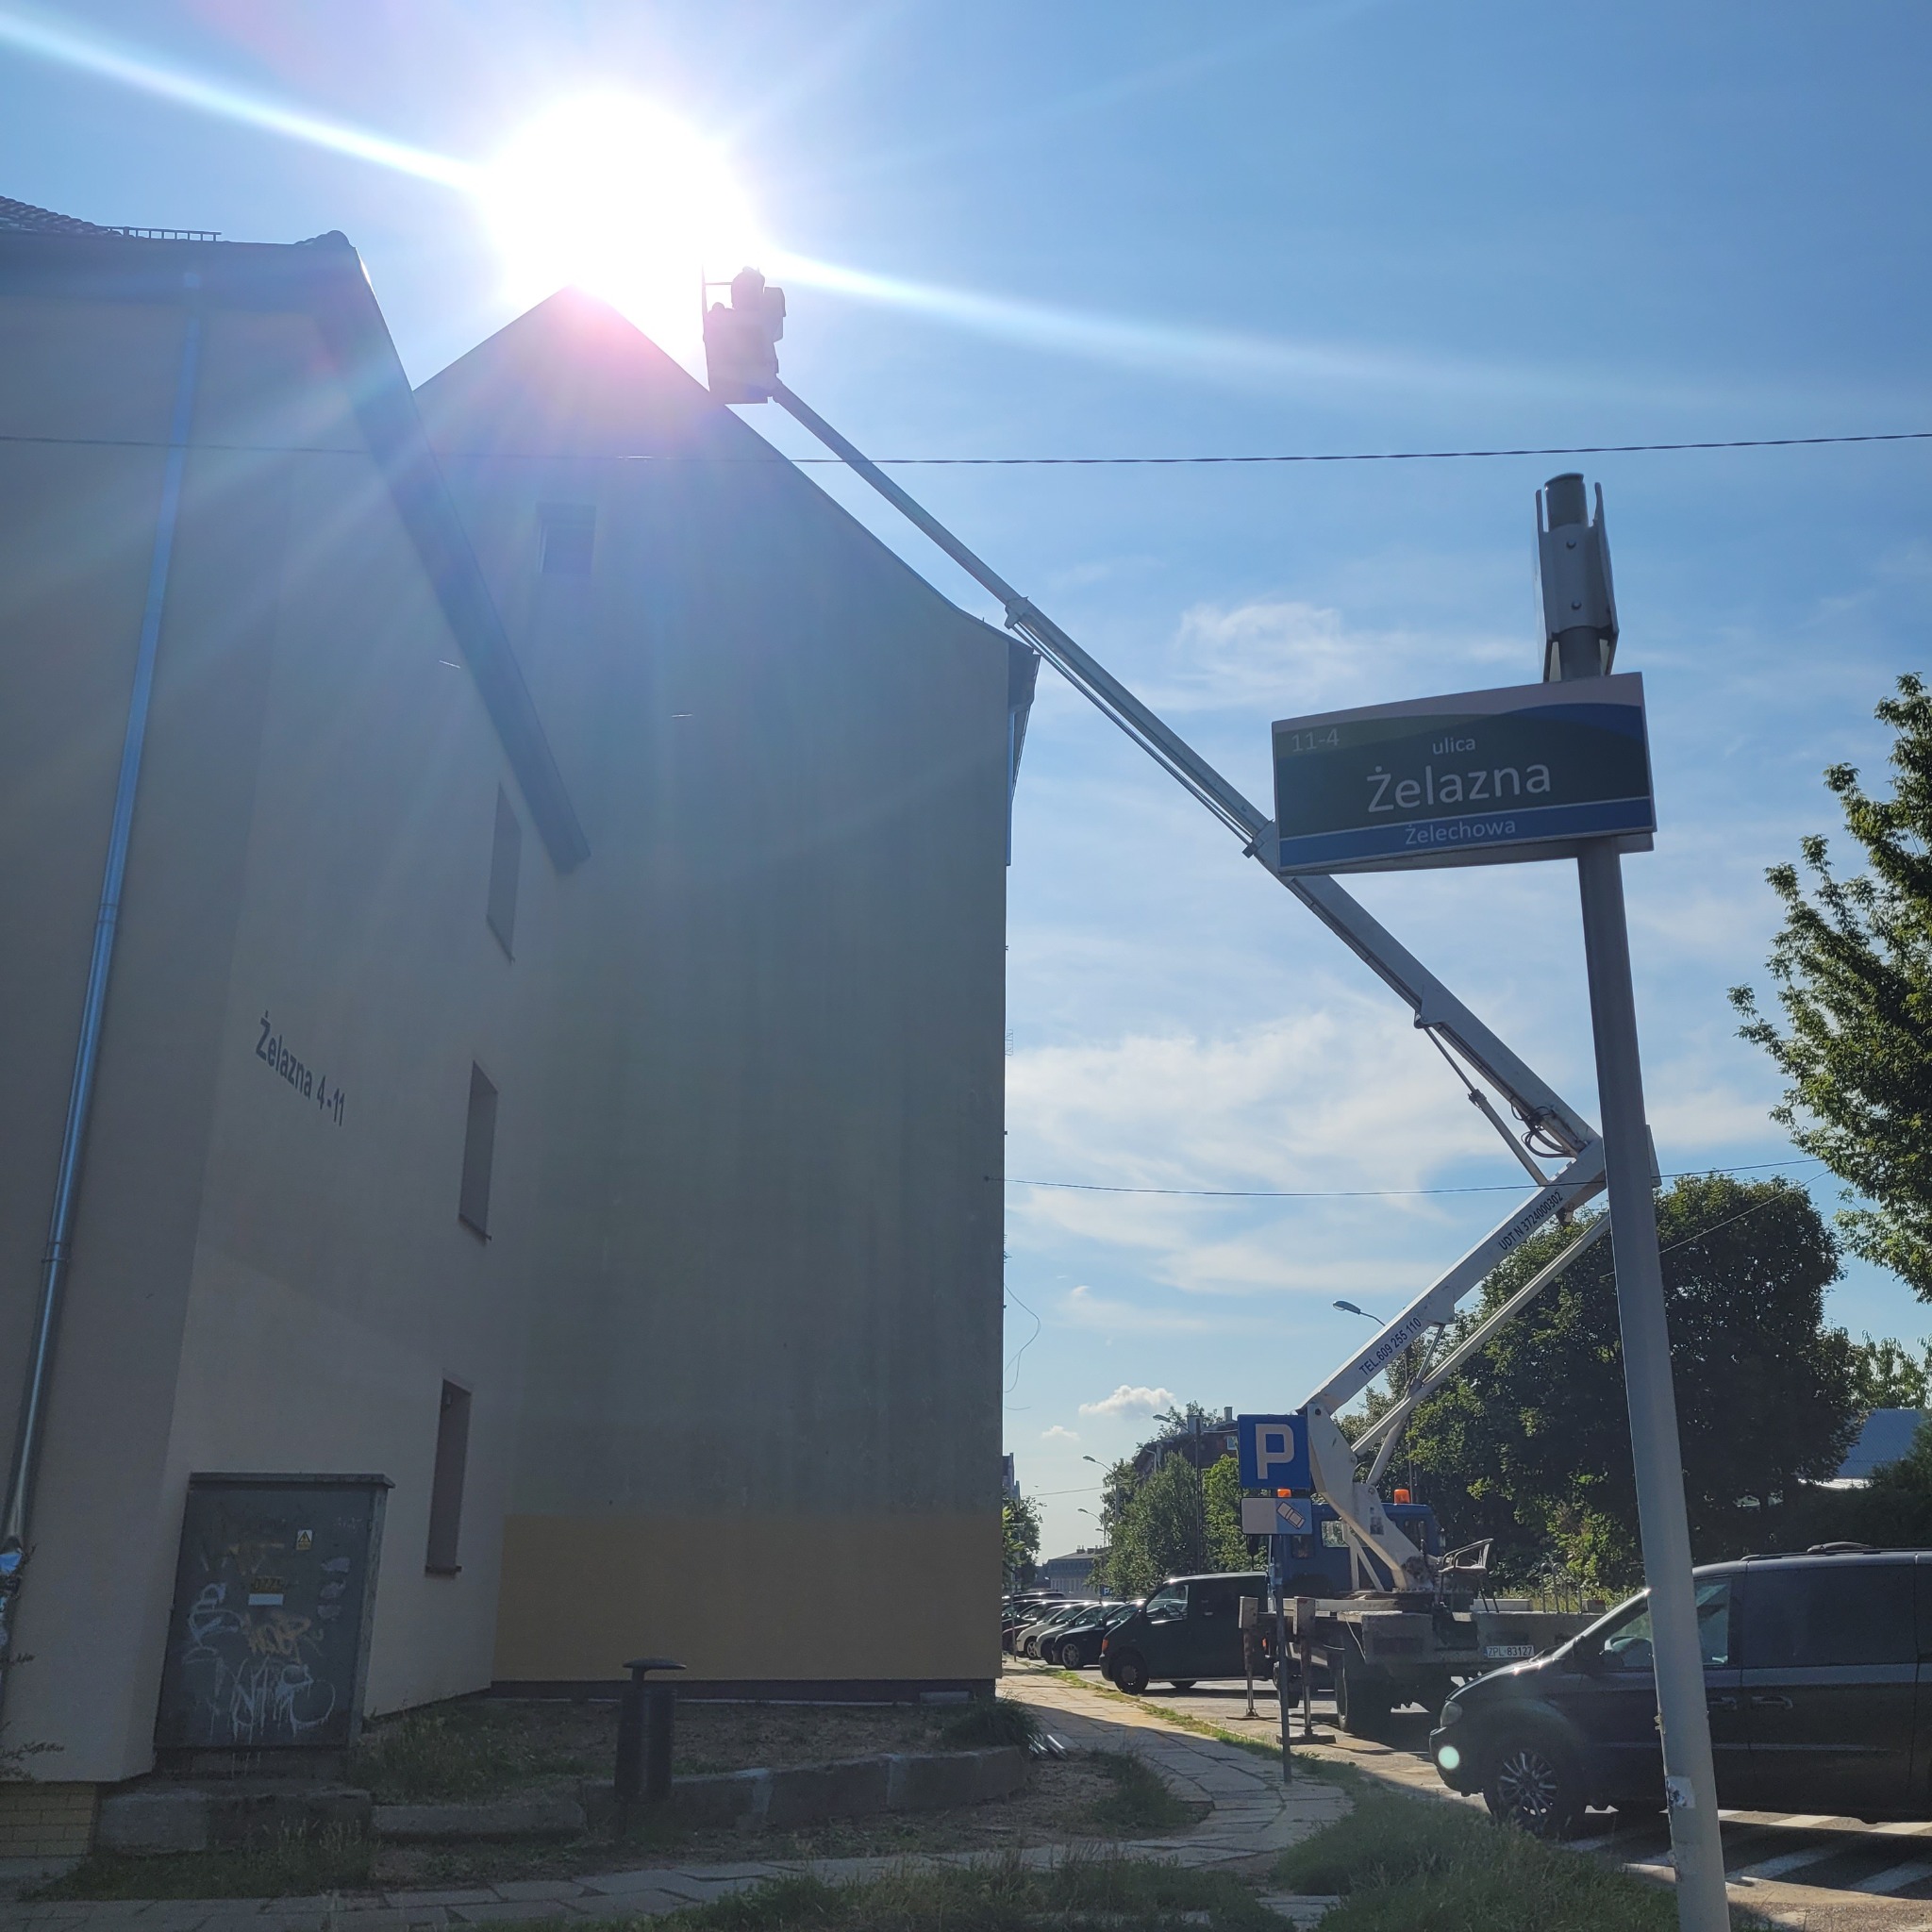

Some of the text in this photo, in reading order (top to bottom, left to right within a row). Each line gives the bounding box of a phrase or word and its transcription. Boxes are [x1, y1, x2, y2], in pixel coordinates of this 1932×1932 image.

[1291, 727, 1341, 753] 11-4
[1432, 736, 1476, 756] ulica
[1366, 762, 1552, 813] Żelazna
[1405, 819, 1516, 845] Żelechowa
[256, 1009, 312, 1100] Żelazna
[1498, 1231, 1517, 1251] UDT
[1516, 1226, 1524, 1238] N
[1391, 1329, 1407, 1348] 255
[1406, 1317, 1422, 1334] 110
[1255, 1423, 1295, 1480] P
[1488, 1646, 1533, 1657] ZPL 83127
